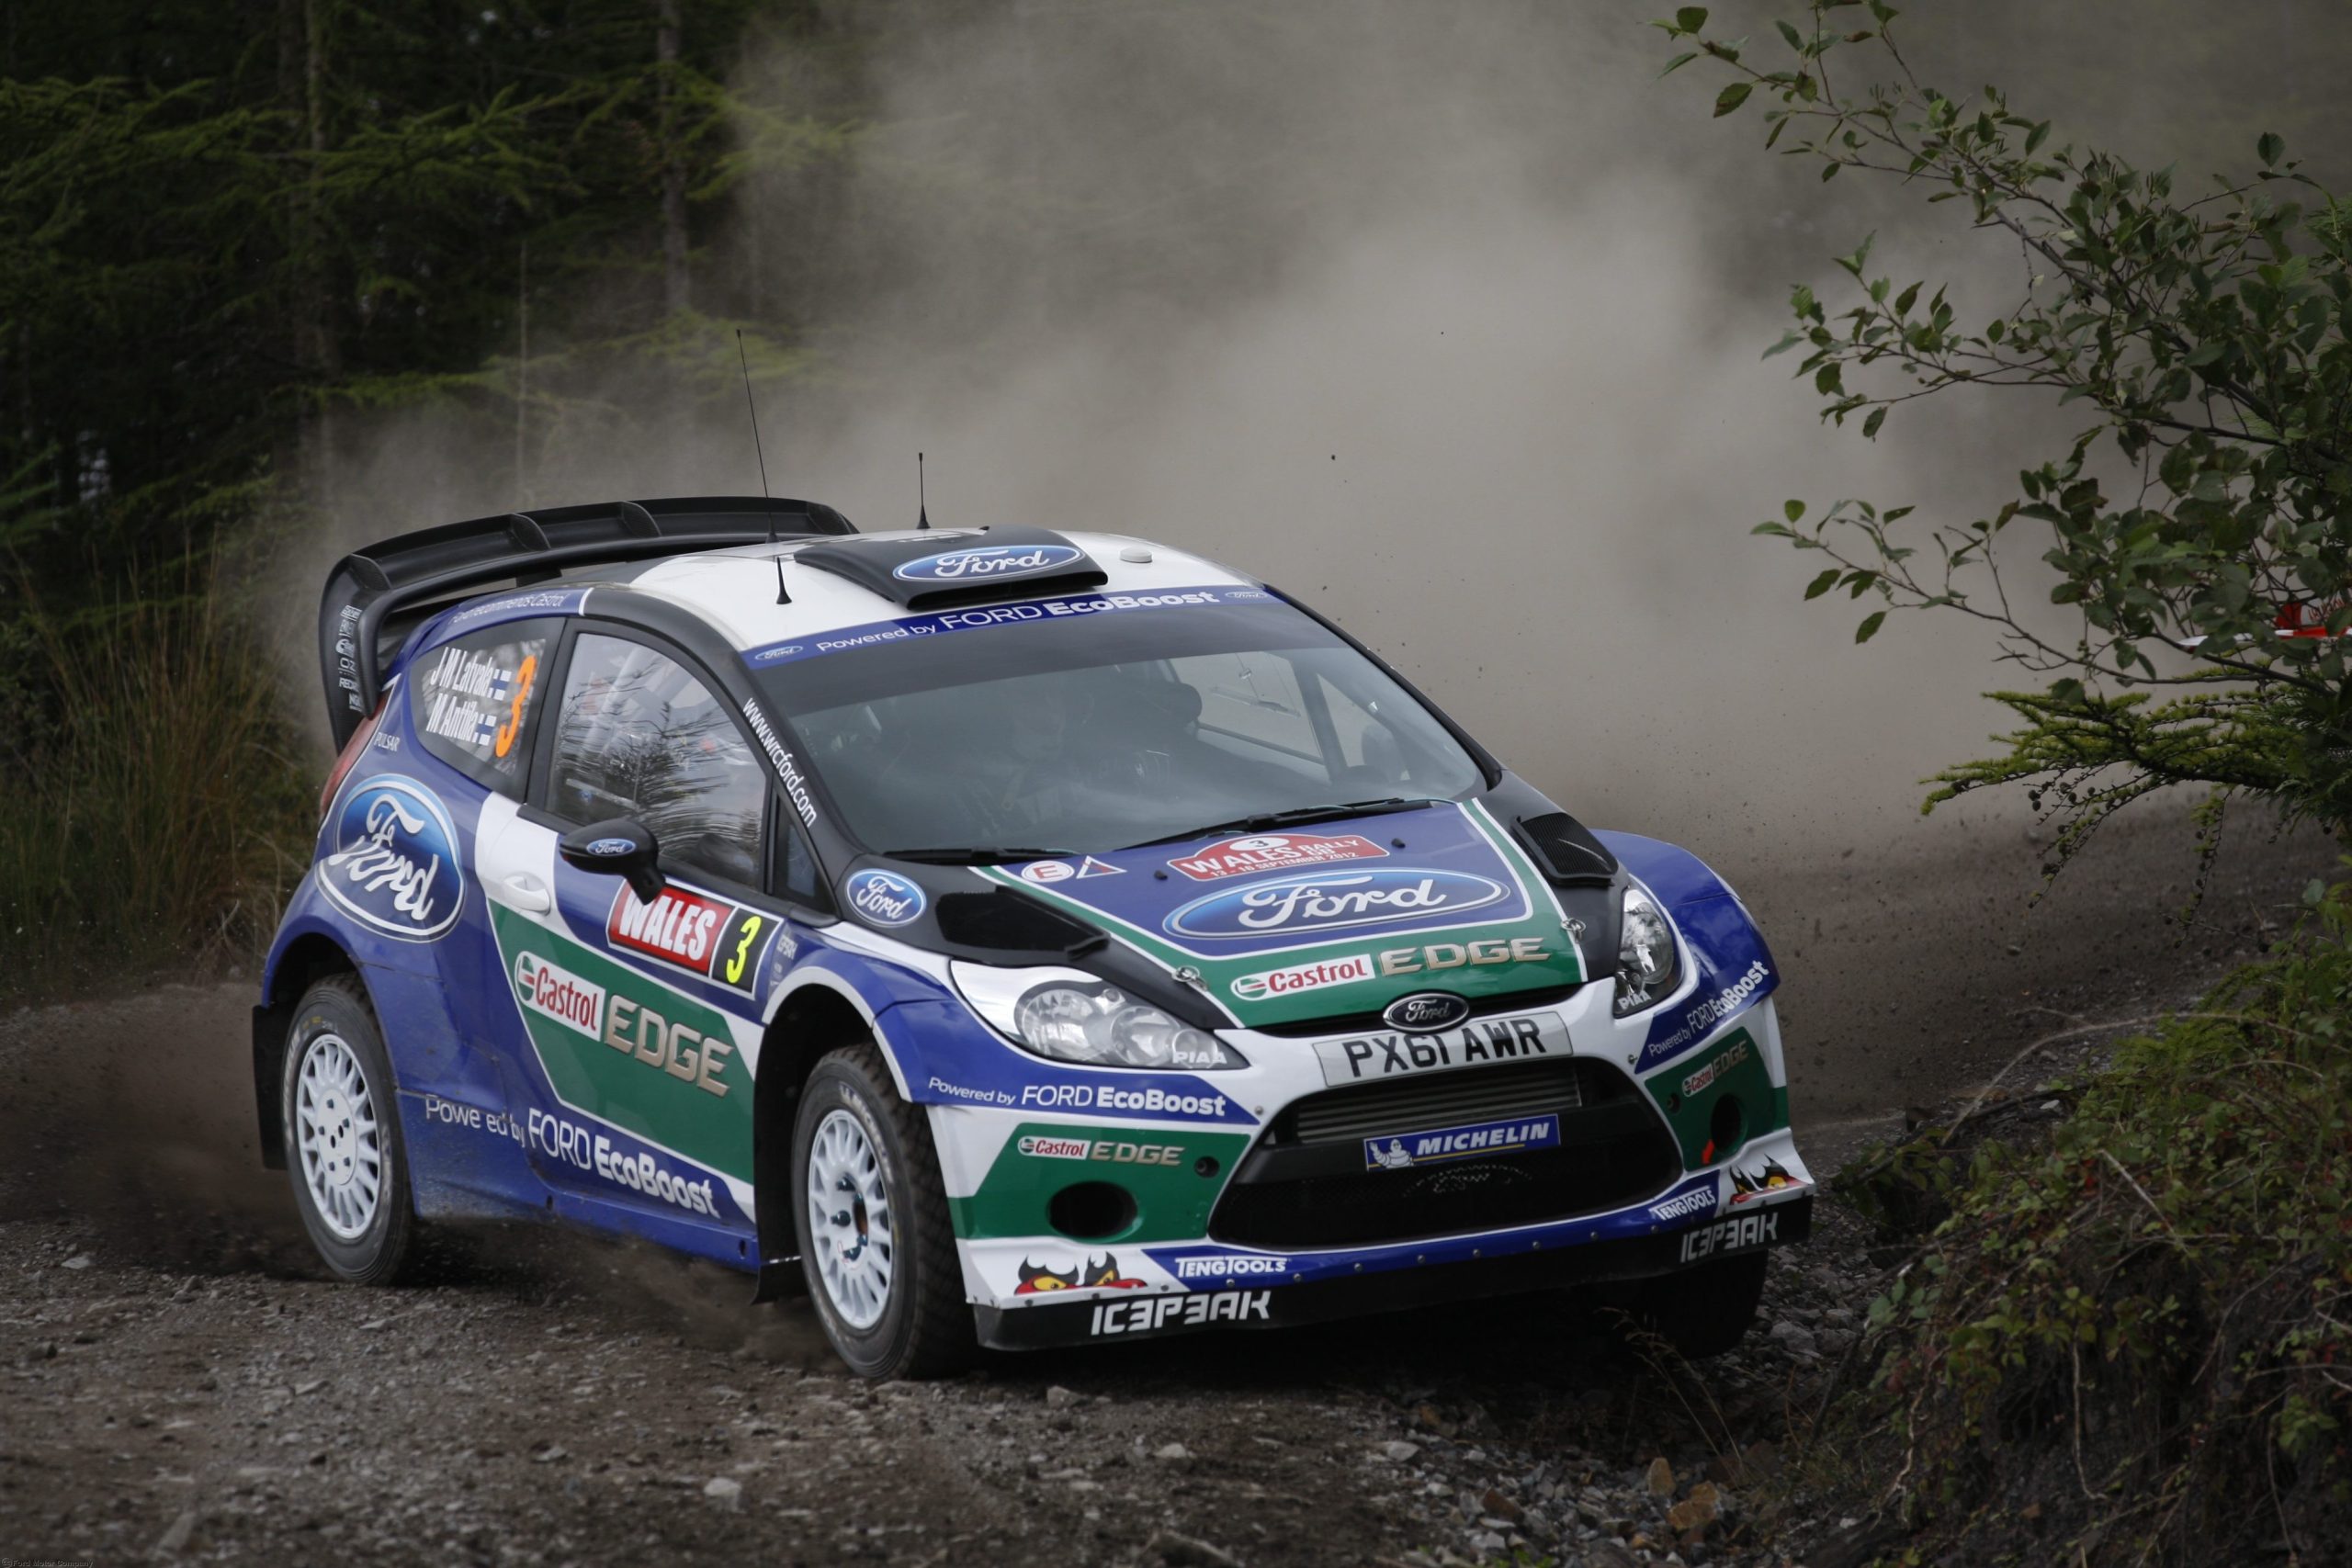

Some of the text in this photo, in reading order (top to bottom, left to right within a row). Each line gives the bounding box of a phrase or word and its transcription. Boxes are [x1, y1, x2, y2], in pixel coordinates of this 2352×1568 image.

[934, 549, 1051, 577] Ford
[816, 591, 1220, 652] Powered by FORD EcoBoost
[763, 646, 797, 660] Ford
[496, 655, 536, 758] 3
[742, 697, 817, 828] www.wrcford.com
[328, 794, 439, 920] Ford
[595, 840, 626, 853] Ford
[1182, 840, 1360, 873] WALES RALLY
[1254, 840, 1269, 848] 3
[1325, 852, 1360, 861] 2012
[856, 875, 912, 919] Ford
[1238, 875, 1448, 928] Ford
[618, 886, 762, 984] WALES 3
[1268, 937, 1552, 992] Castrol EDGE
[1406, 998, 1451, 1022] Ford
[1617, 990, 1652, 1010] PIAA
[1648, 1033, 1682, 1056] Powered
[1687, 1003, 1715, 1034] FORD
[1711, 960, 1770, 1018] EcoBoost
[536, 967, 734, 1098] Castrol EDGE
[1342, 1019, 1547, 1077] PX61 AWR
[1172, 1051, 1227, 1064] PIAA
[1713, 1040, 1749, 1077] EDGE
[928, 1077, 1227, 1116] Powered by FORD EcoBoost
[425, 1094, 509, 1136] Poweed
[528, 1107, 591, 1170] FORD
[594, 1134, 721, 1219] EcoBoost
[1035, 1139, 1186, 1167] Castrol EDGE
[1417, 1122, 1550, 1156] MICHELIN
